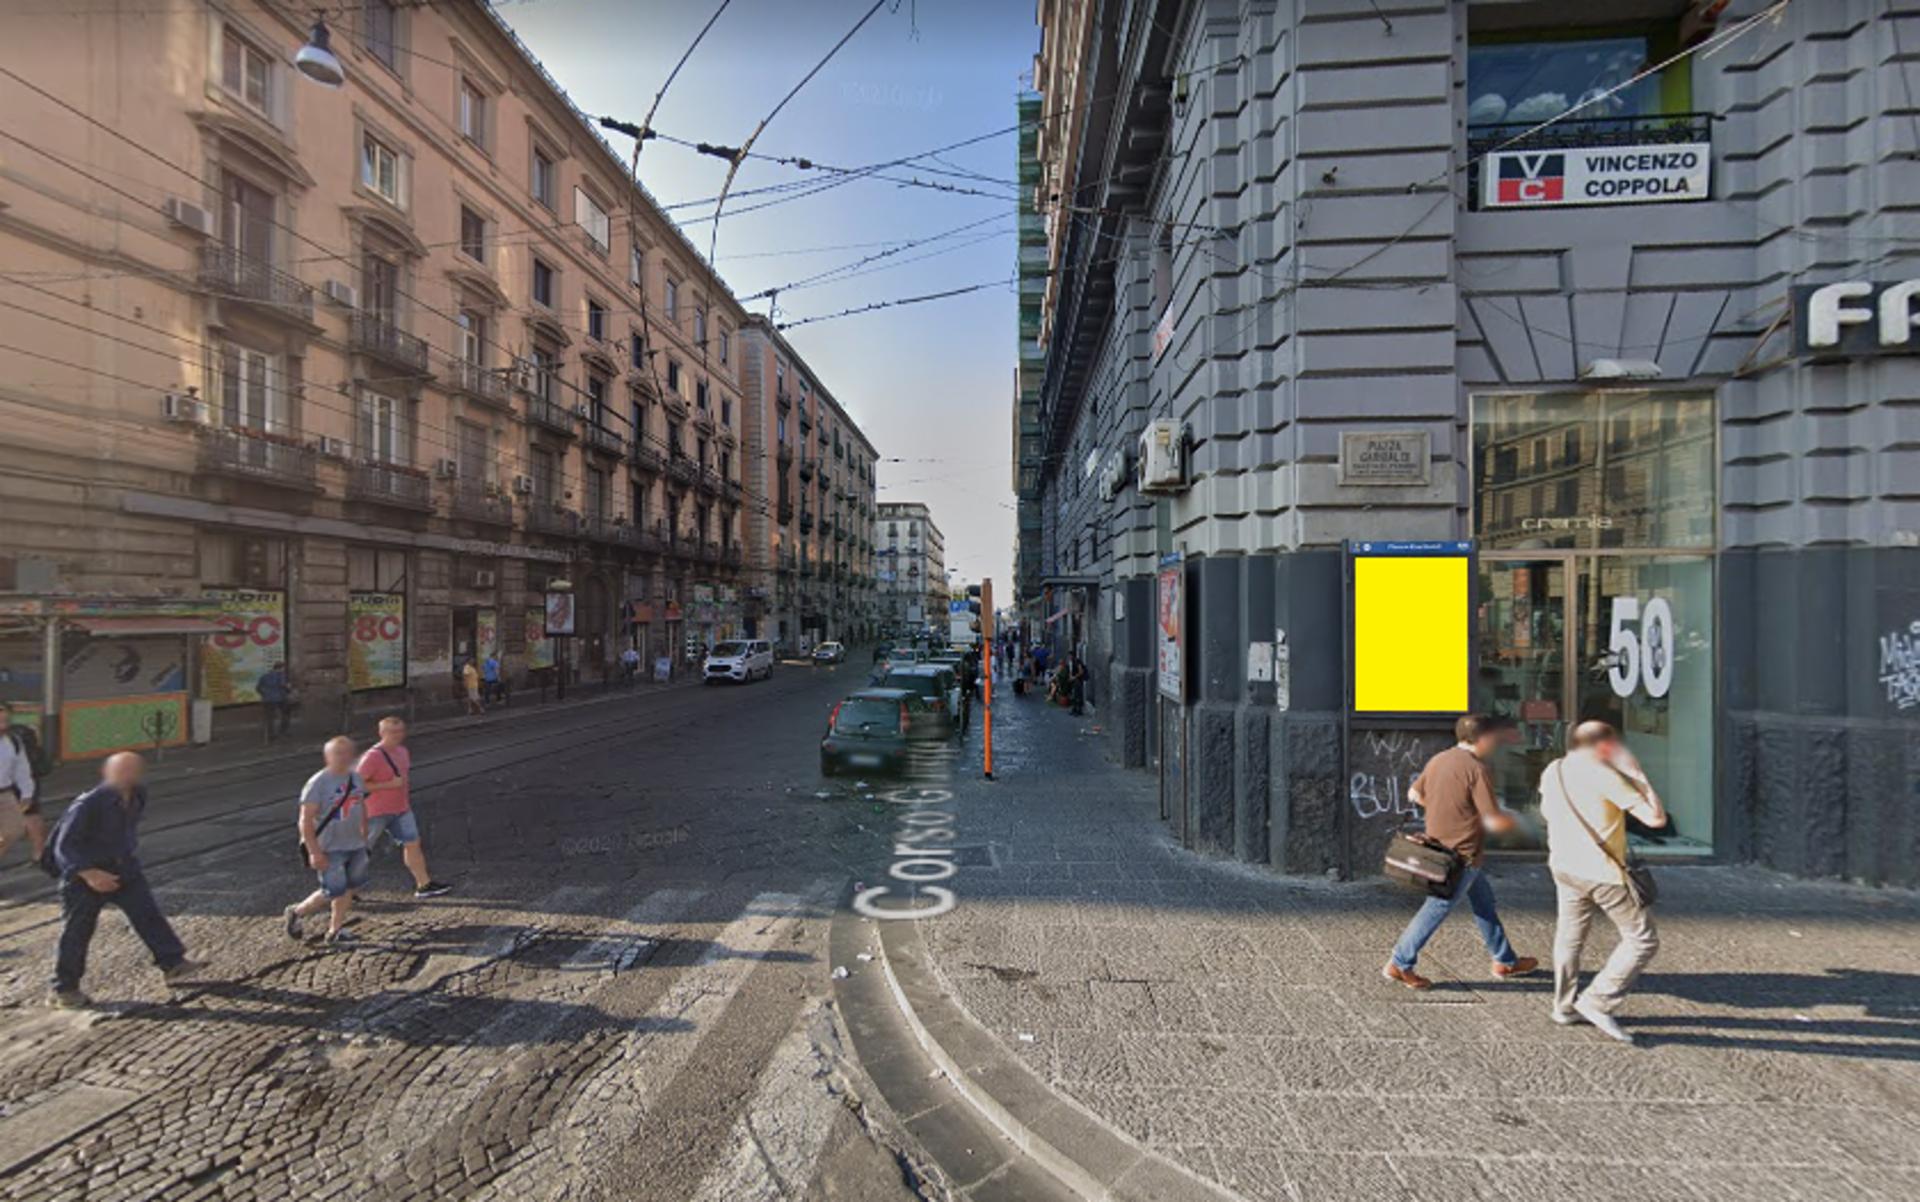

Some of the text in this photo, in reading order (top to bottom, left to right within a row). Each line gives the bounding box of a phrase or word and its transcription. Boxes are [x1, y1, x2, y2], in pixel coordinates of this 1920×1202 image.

[1517, 154, 1548, 179] V
[1585, 152, 1698, 173] VINCENZO
[1519, 179, 1546, 200] C
[1585, 177, 1690, 197] COPPOLA
[1368, 440, 1402, 451] PIAZZA
[1608, 596, 1674, 699] 50
